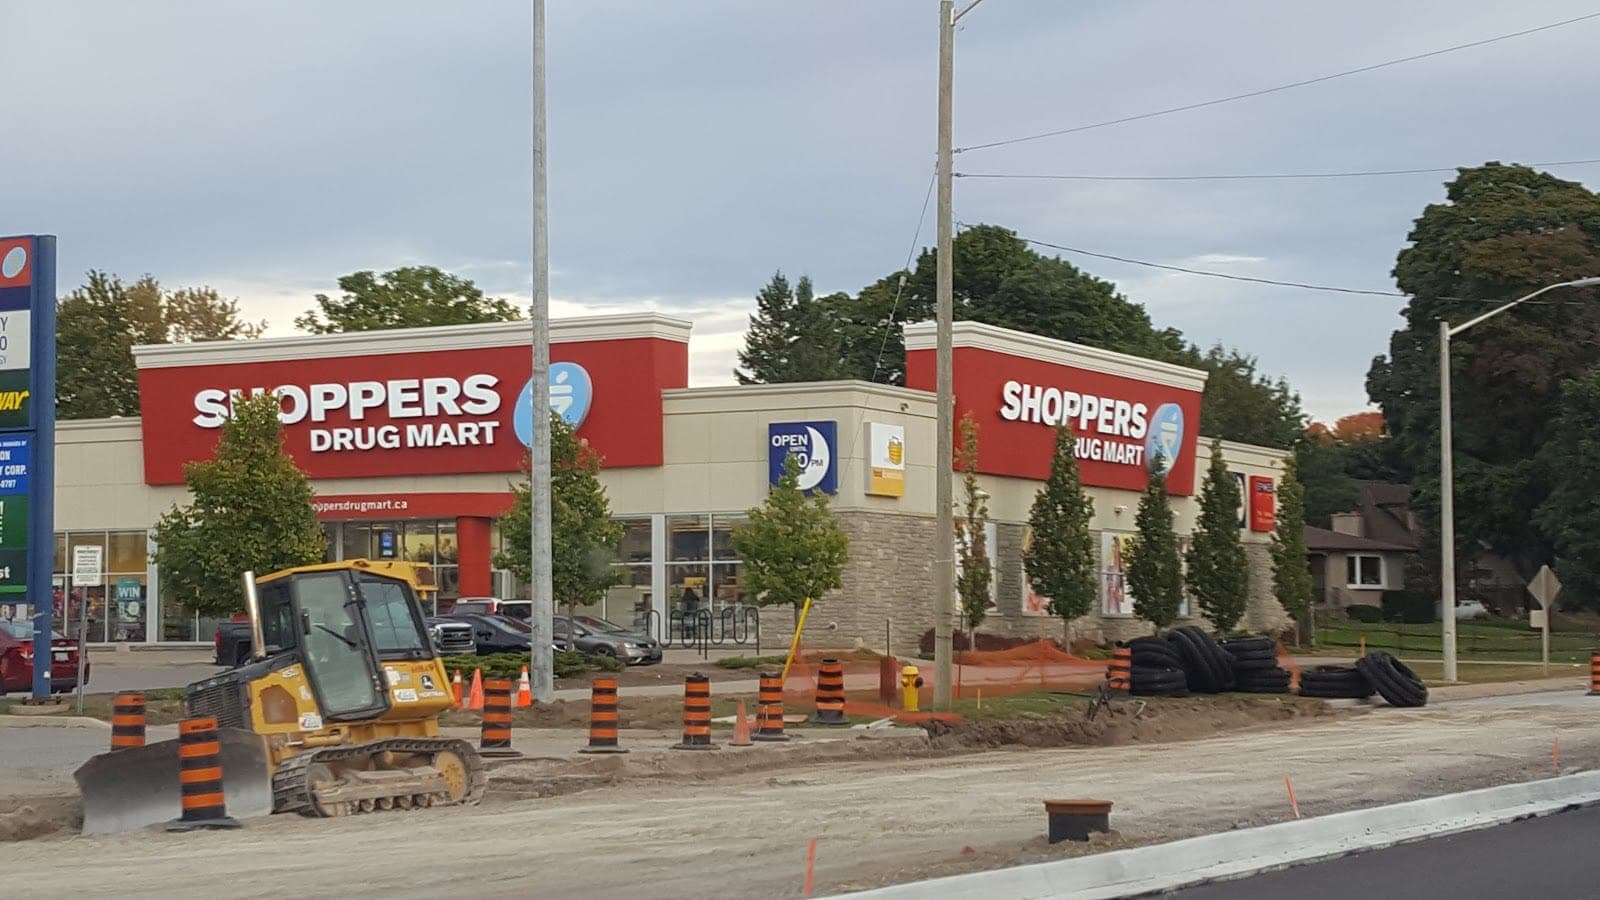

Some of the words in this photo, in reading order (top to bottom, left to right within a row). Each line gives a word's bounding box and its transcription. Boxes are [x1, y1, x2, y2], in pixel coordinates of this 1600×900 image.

[1000, 381, 1148, 439] SHOPPERS
[310, 425, 401, 451] DRUG
[406, 421, 500, 447] MART
[772, 434, 808, 447] OPEN
[1073, 437, 1101, 460] RUG
[1103, 440, 1144, 466] MART
[4, 464, 27, 476] CORP.
[118, 587, 140, 598] WIN
